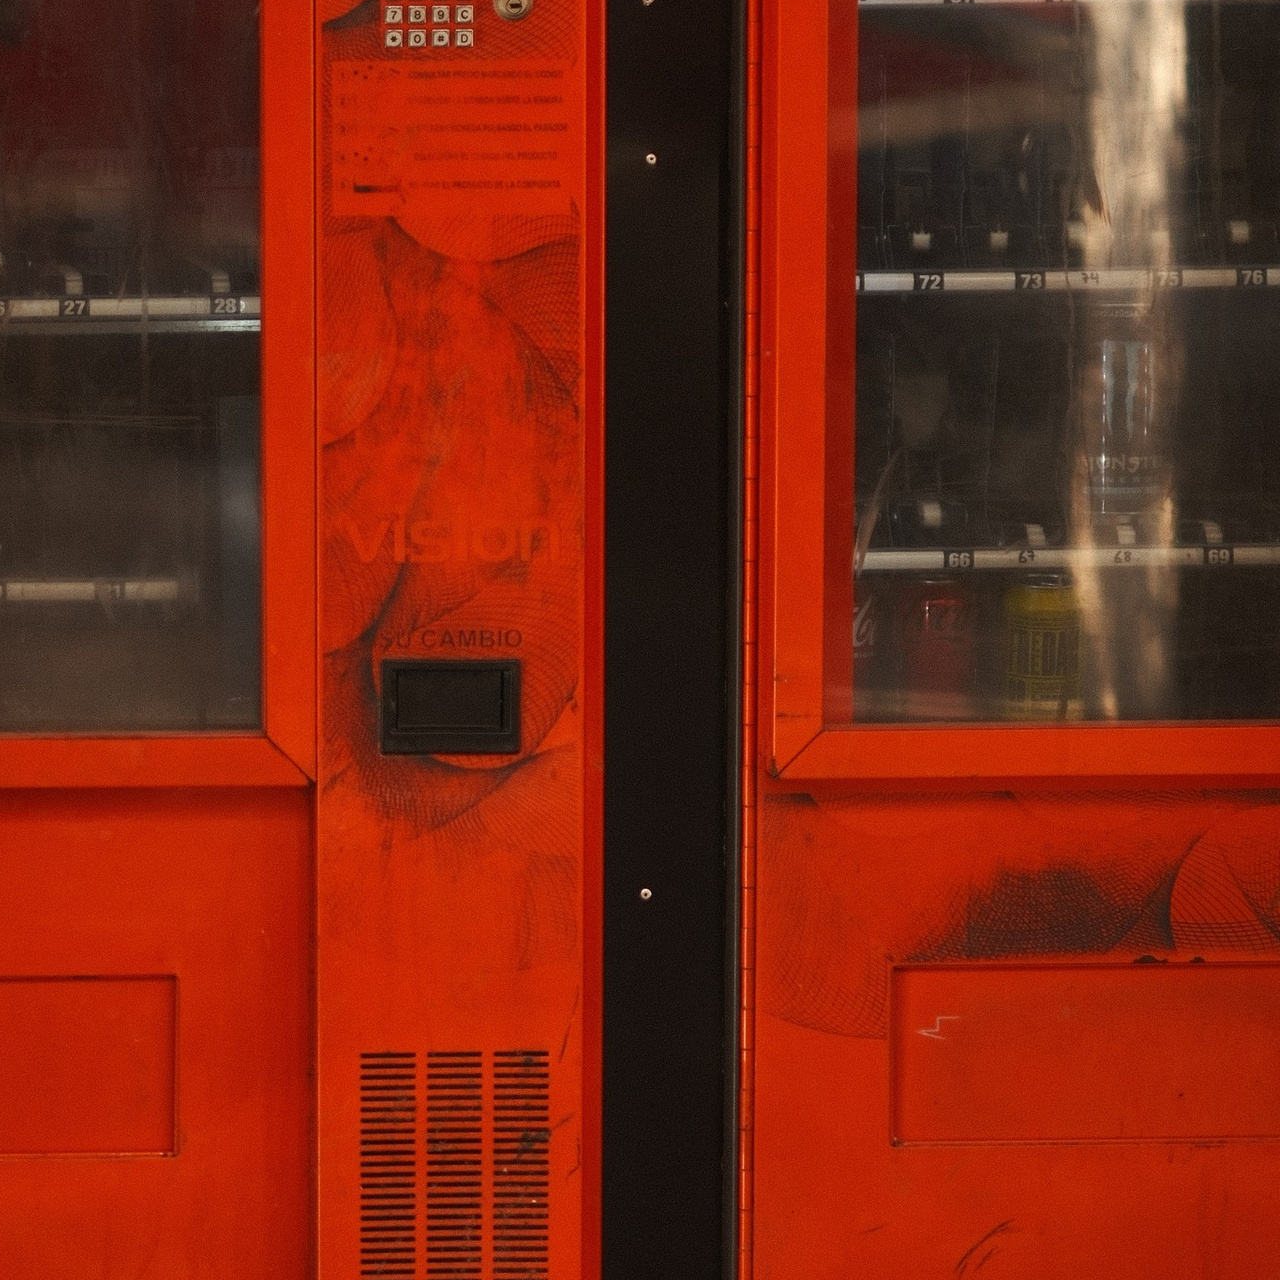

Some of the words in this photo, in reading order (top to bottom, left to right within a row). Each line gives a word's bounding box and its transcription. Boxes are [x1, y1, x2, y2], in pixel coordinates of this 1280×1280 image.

[390, 10, 397, 19] 7
[414, 10, 421, 19] 8
[437, 10, 445, 19] 9
[460, 10, 468, 19] C
[414, 34, 421, 43] 0
[460, 34, 468, 43] D
[919, 275, 942, 290] 72
[1021, 274, 1043, 289] 73
[1158, 271, 1180, 286] 75
[1242, 270, 1264, 285] 76
[64, 301, 85, 316] 27
[215, 299, 237, 313] 28
[948, 552, 970, 567] 66
[1209, 549, 1230, 563] 69
[381, 630, 411, 648] SU
[421, 629, 522, 648] CAMBIO
